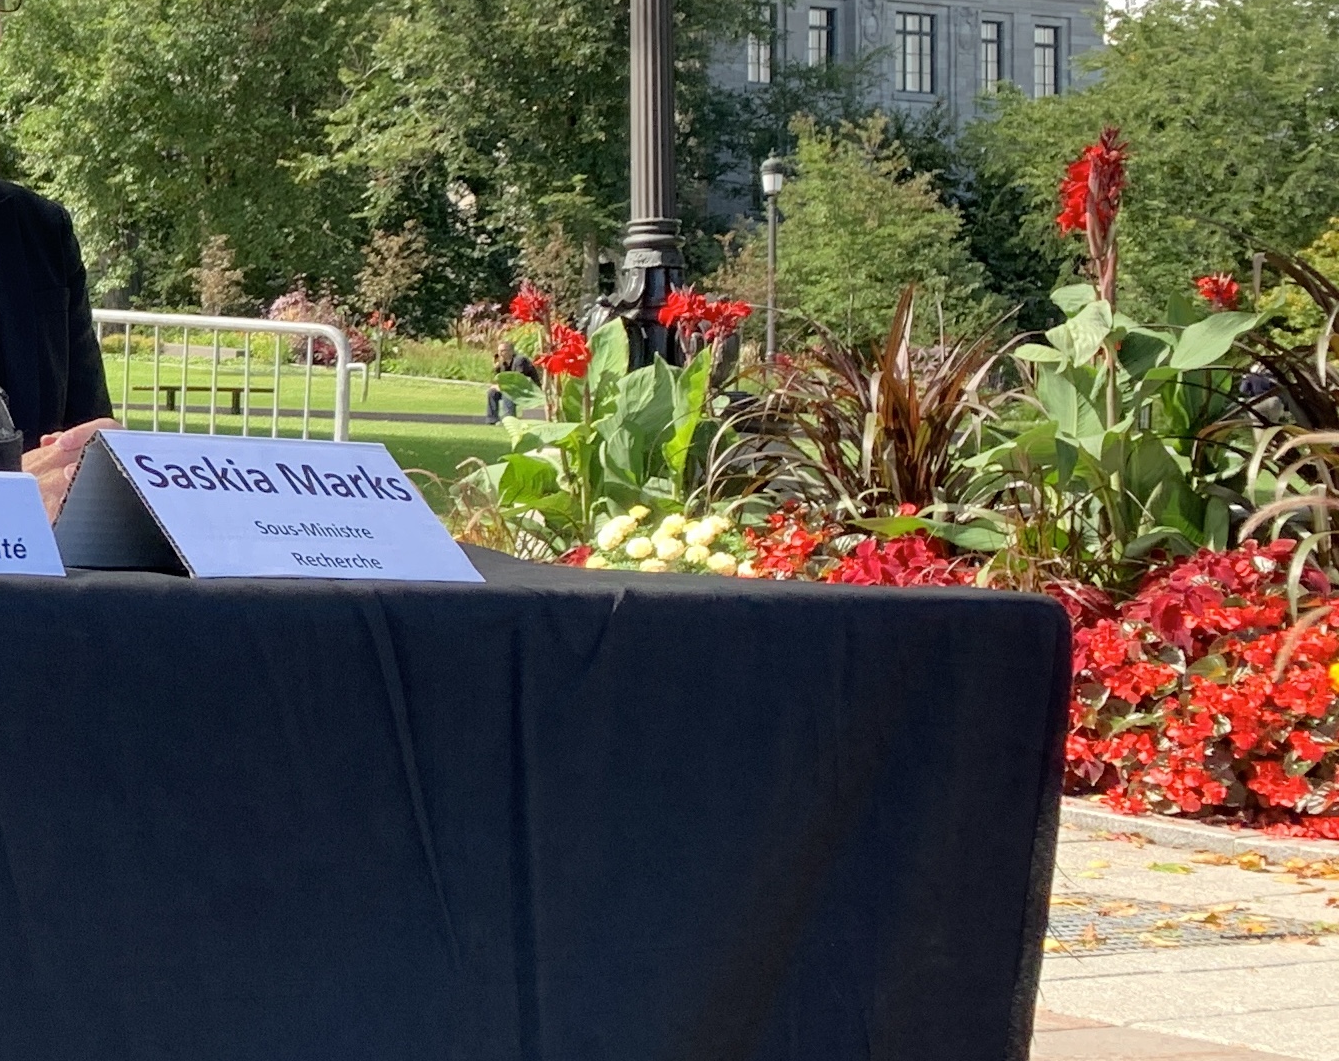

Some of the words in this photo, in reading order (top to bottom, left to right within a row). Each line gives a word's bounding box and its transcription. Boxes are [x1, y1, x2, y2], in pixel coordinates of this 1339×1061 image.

[134, 454, 280, 495] Saskia
[279, 462, 413, 502] Marks
[254, 520, 375, 539] Sous-Ministre
[291, 552, 384, 570] Recherche
